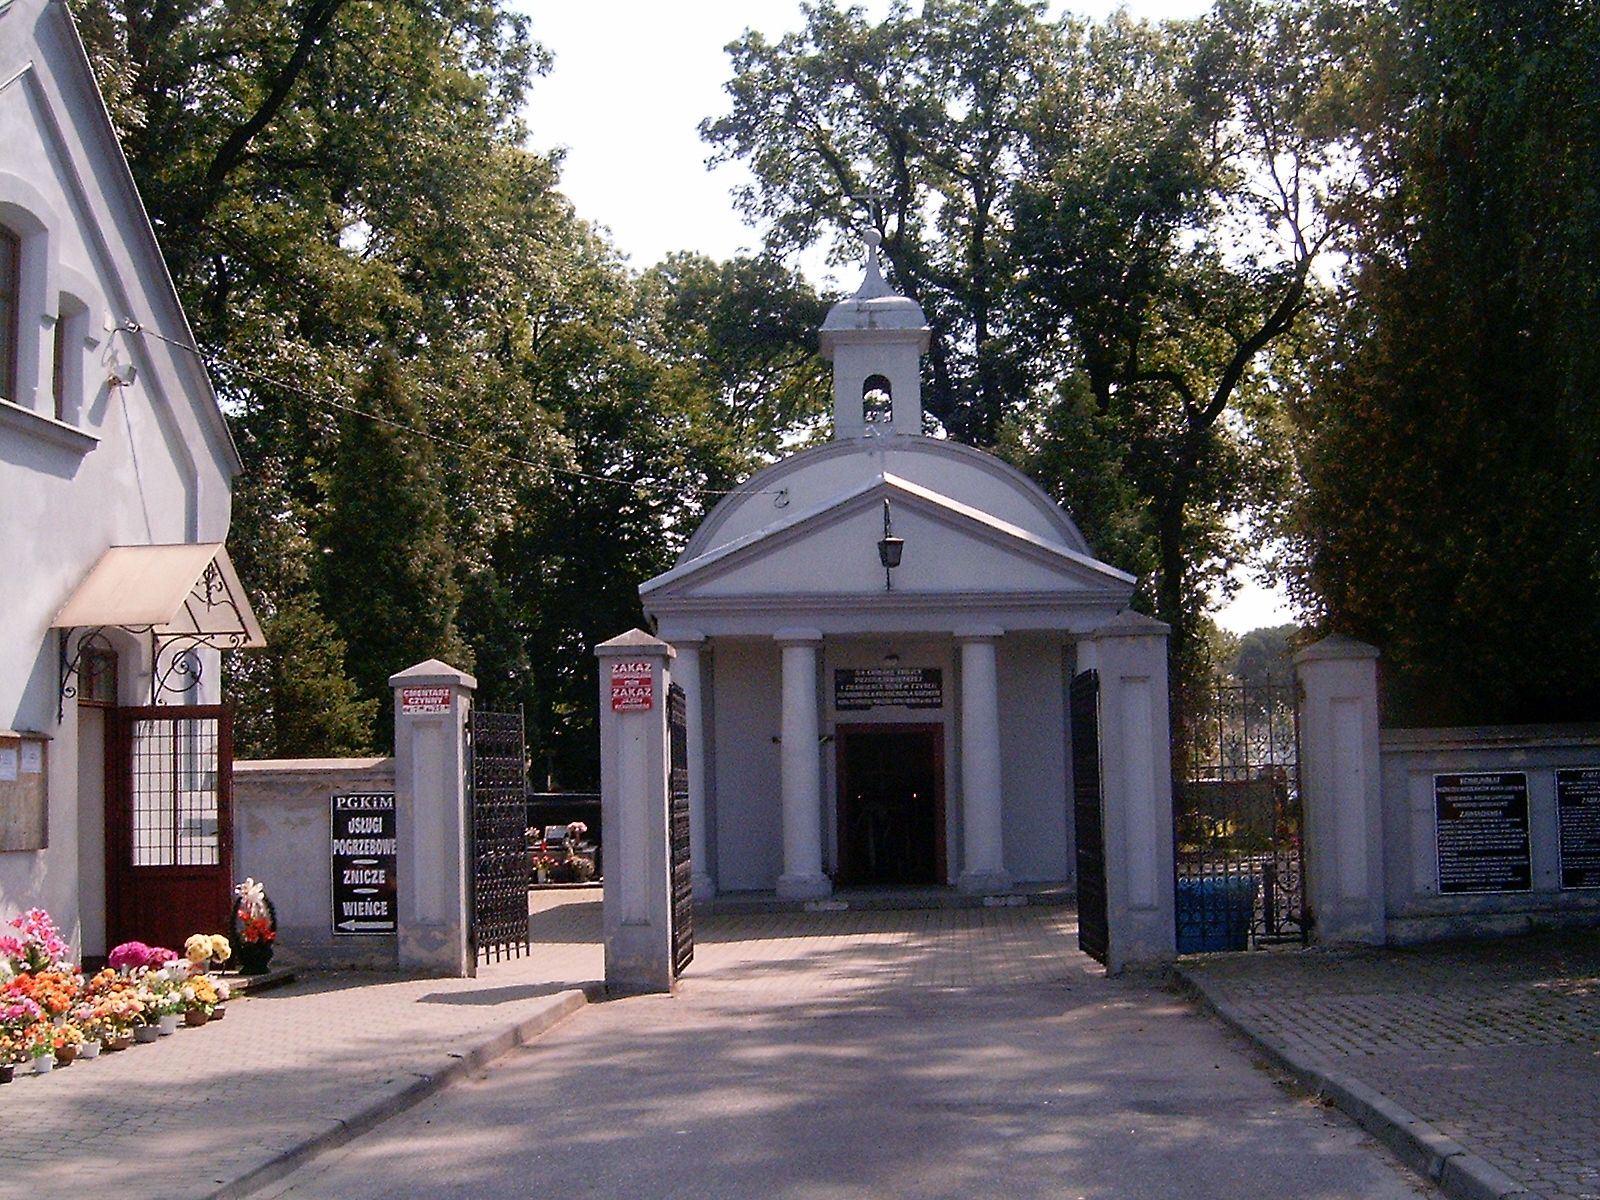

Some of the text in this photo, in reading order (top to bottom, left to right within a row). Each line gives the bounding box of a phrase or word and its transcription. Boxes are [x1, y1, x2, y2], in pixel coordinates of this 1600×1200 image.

[612, 663, 651, 673] ZAKAZ
[403, 688, 449, 697] CMENTARZ
[612, 688, 651, 697] ZAKAZ
[336, 796, 394, 809] PGKiM
[348, 817, 383, 834] USŁUGI
[333, 838, 397, 855] POGRZEBOWE
[343, 870, 386, 884] ZNICZE
[342, 897, 388, 916] WIEŃCE
